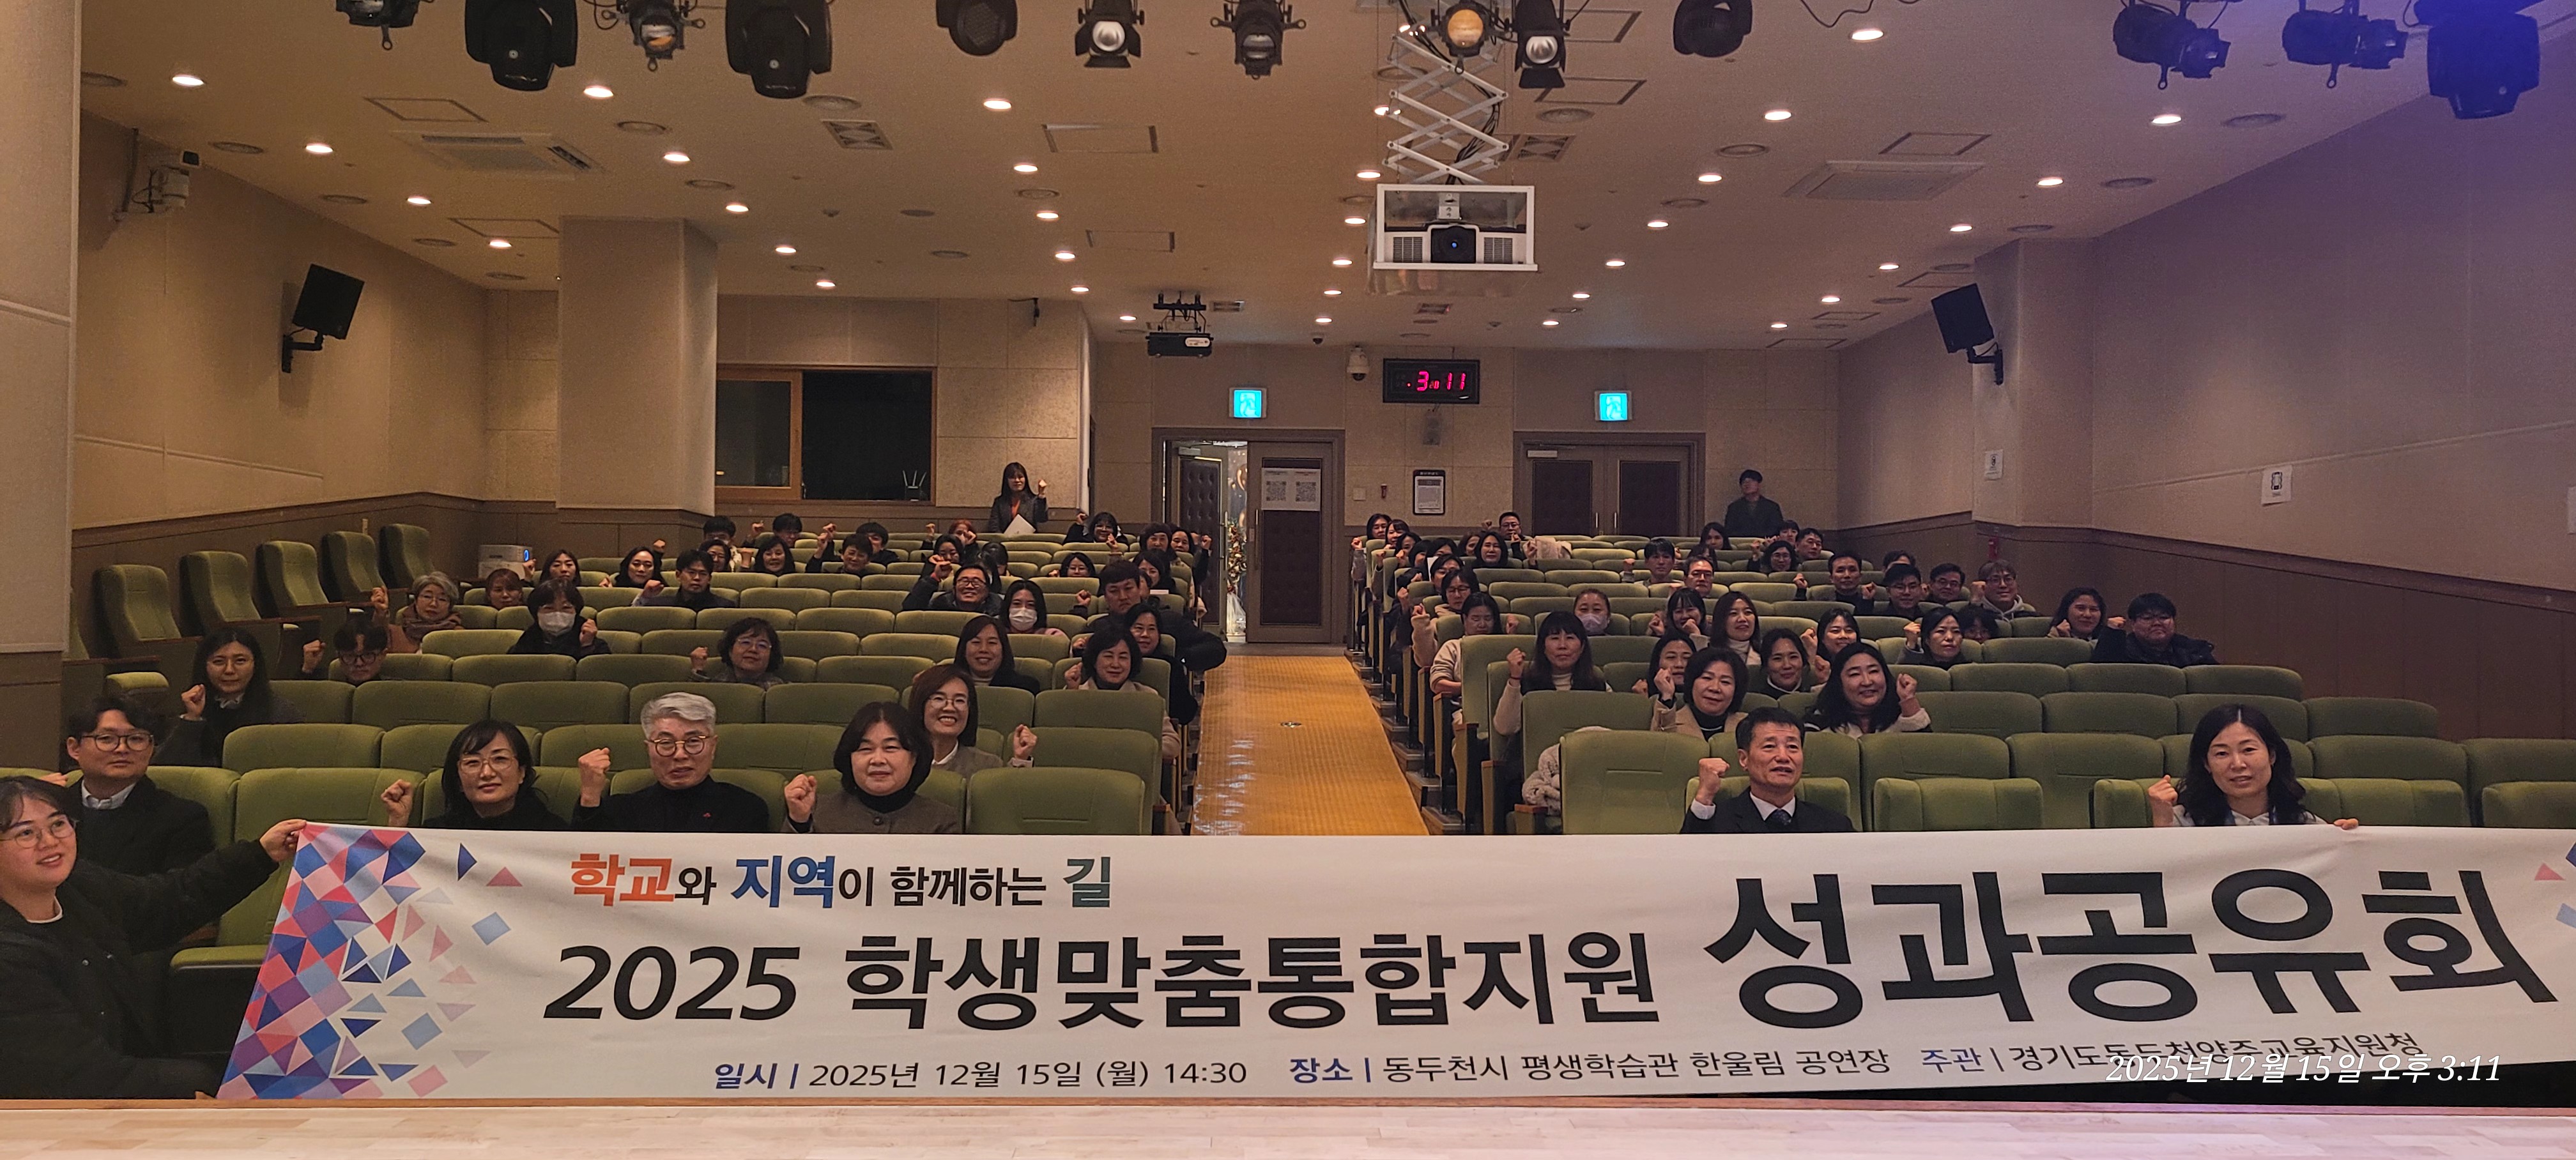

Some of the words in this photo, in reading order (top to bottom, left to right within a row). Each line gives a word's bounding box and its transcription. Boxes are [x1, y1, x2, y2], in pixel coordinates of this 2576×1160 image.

[570, 853, 717, 908] 학교와
[729, 855, 874, 909] 지역이
[889, 866, 1046, 907] 함께하는
[1062, 856, 1114, 908] 길
[543, 945, 801, 1021] 2025
[845, 931, 1660, 1031] 학생맞춤통합지원
[1703, 868, 2559, 1030] 성과공유회
[712, 1062, 778, 1090] 일시
[808, 1062, 919, 1089] 2025년
[936, 1061, 1000, 1088] 12월
[1017, 1061, 1080, 1088] 15일
[1097, 1060, 1148, 1088] (월)
[1165, 1062, 1246, 1084] 14:30
[1289, 1057, 1353, 1084] 장소
[1383, 1055, 1508, 1083] 동두천시
[1521, 1052, 1679, 1081] 평생학습관
[1689, 1051, 1784, 1078] 한울림
[1795, 1048, 1890, 1076] 공연장
[1920, 1046, 1985, 1074] 주관
